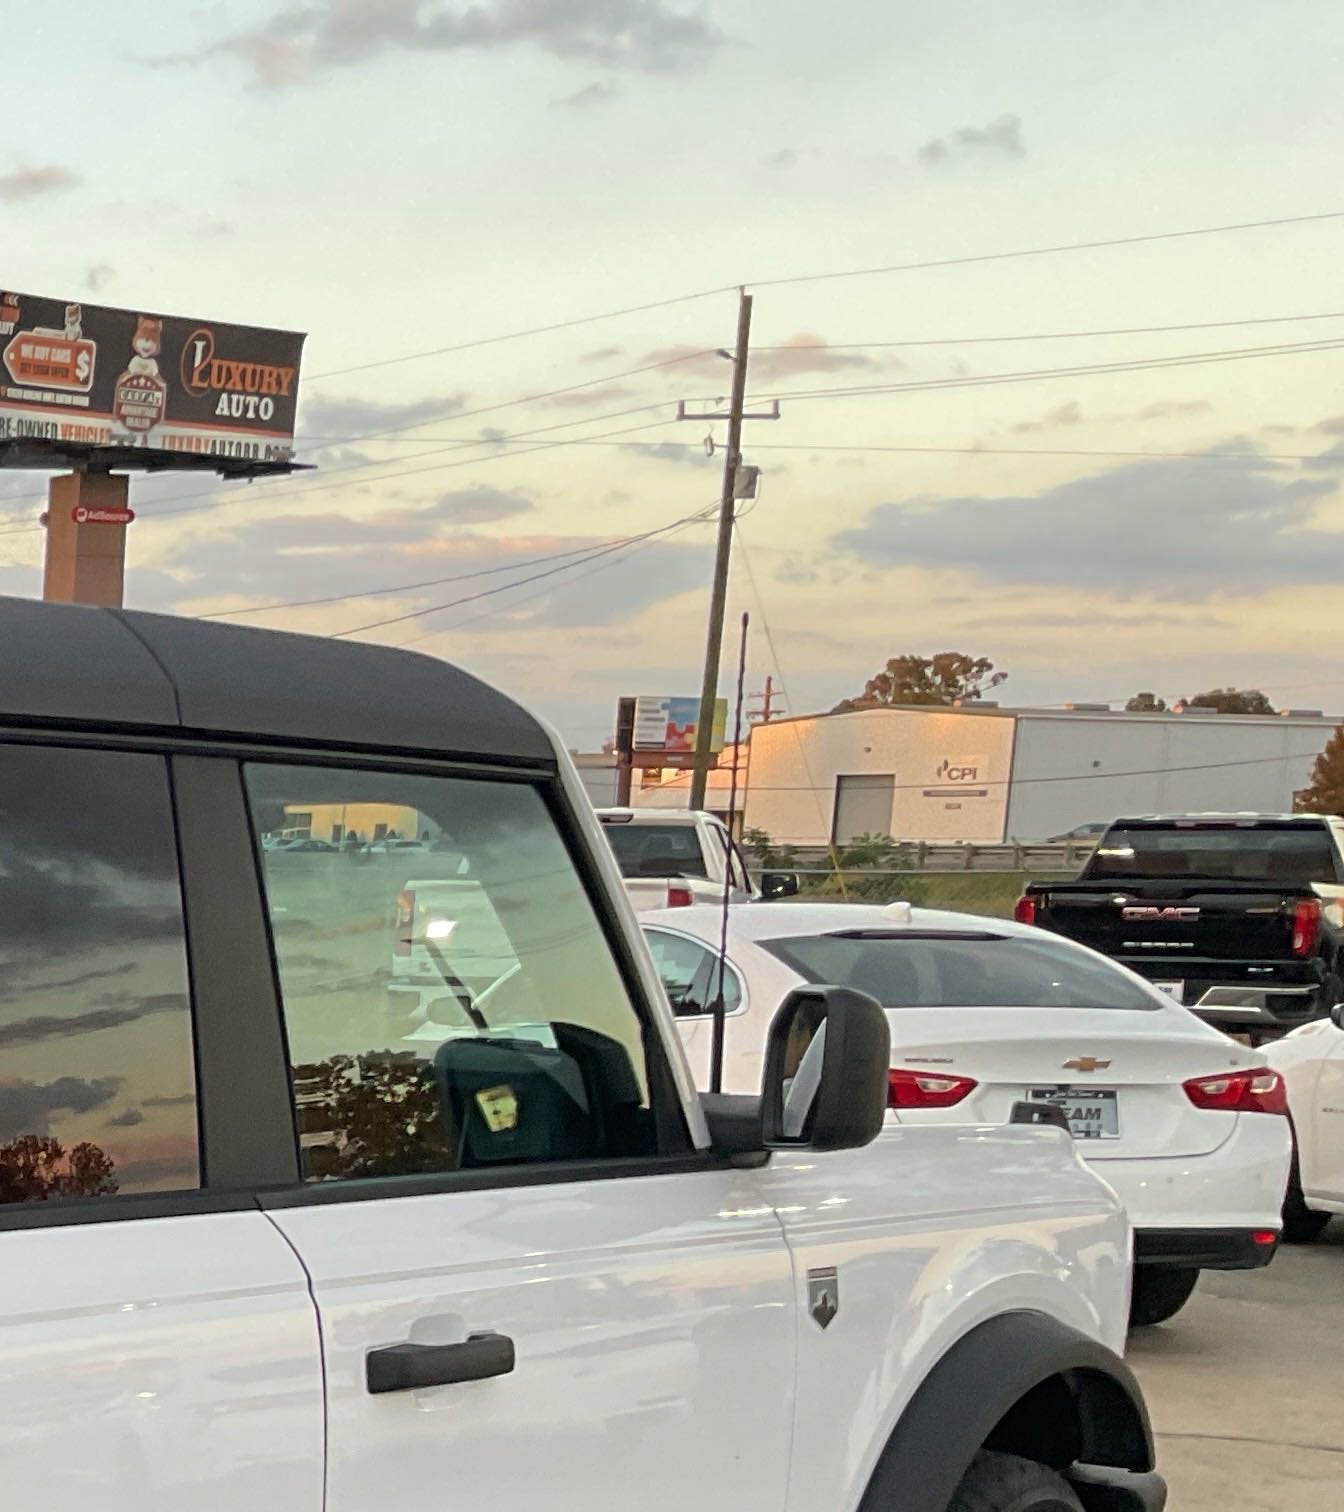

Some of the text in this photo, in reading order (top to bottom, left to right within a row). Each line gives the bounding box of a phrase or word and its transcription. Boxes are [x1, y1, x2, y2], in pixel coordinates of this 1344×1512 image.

[190, 340, 295, 397] LUXURY
[119, 389, 162, 406] CARFAX
[215, 391, 275, 421] AUTO
[60, 423, 113, 446] VEHICLES
[947, 767, 978, 781] CPI
[1122, 906, 1201, 922] GMC
